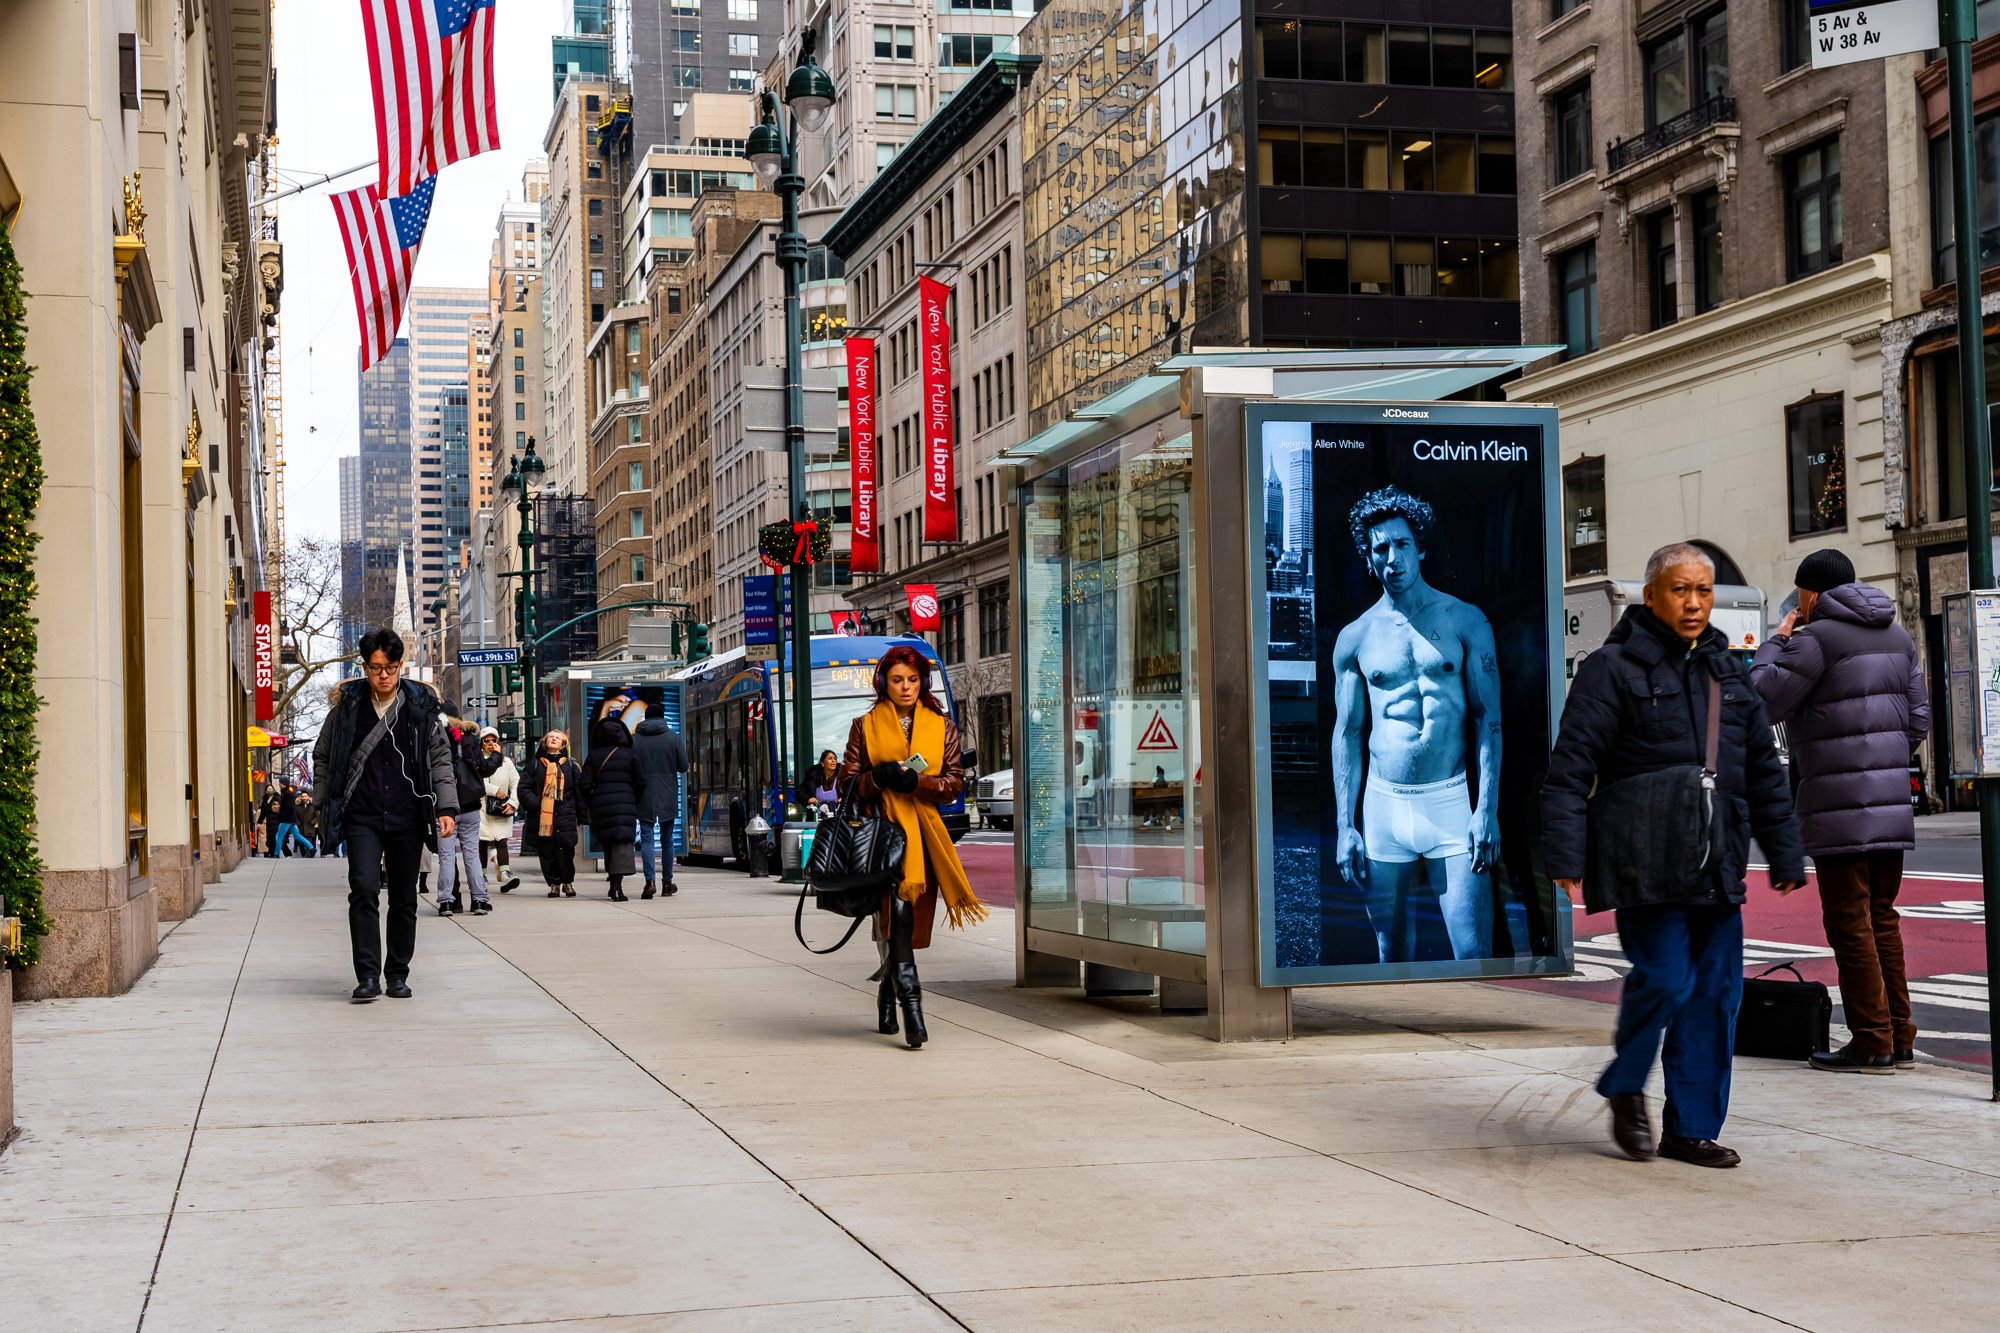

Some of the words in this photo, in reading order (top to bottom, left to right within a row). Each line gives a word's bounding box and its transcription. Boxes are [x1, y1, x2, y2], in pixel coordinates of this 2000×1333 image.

[1819, 19, 1827, 32] 5
[1833, 15, 1850, 30] Av
[1856, 11, 1867, 26] &
[1819, 37, 1834, 52] W
[1840, 33, 1857, 49] 38
[1863, 30, 1880, 45] Av
[928, 299, 942, 337] New
[855, 356, 869, 390] New
[931, 344, 946, 376] York
[857, 395, 871, 425] York
[932, 384, 948, 430] Public
[1382, 409, 1429, 419] JCDecaux
[858, 432, 873, 474] Public
[1279, 440, 1312, 450] Jeremy
[1314, 439, 1337, 449] Allen
[1338, 439, 1365, 449] White
[1413, 439, 1477, 461] Calvin
[1481, 440, 1528, 461] Klein
[930, 437, 949, 502] Library
[855, 480, 873, 538] Library
[255, 623, 271, 687] STAPLES
[461, 654, 483, 662] West
[484, 652, 503, 661] 39th
[504, 652, 514, 660] St
[831, 669, 853, 680] EAST
